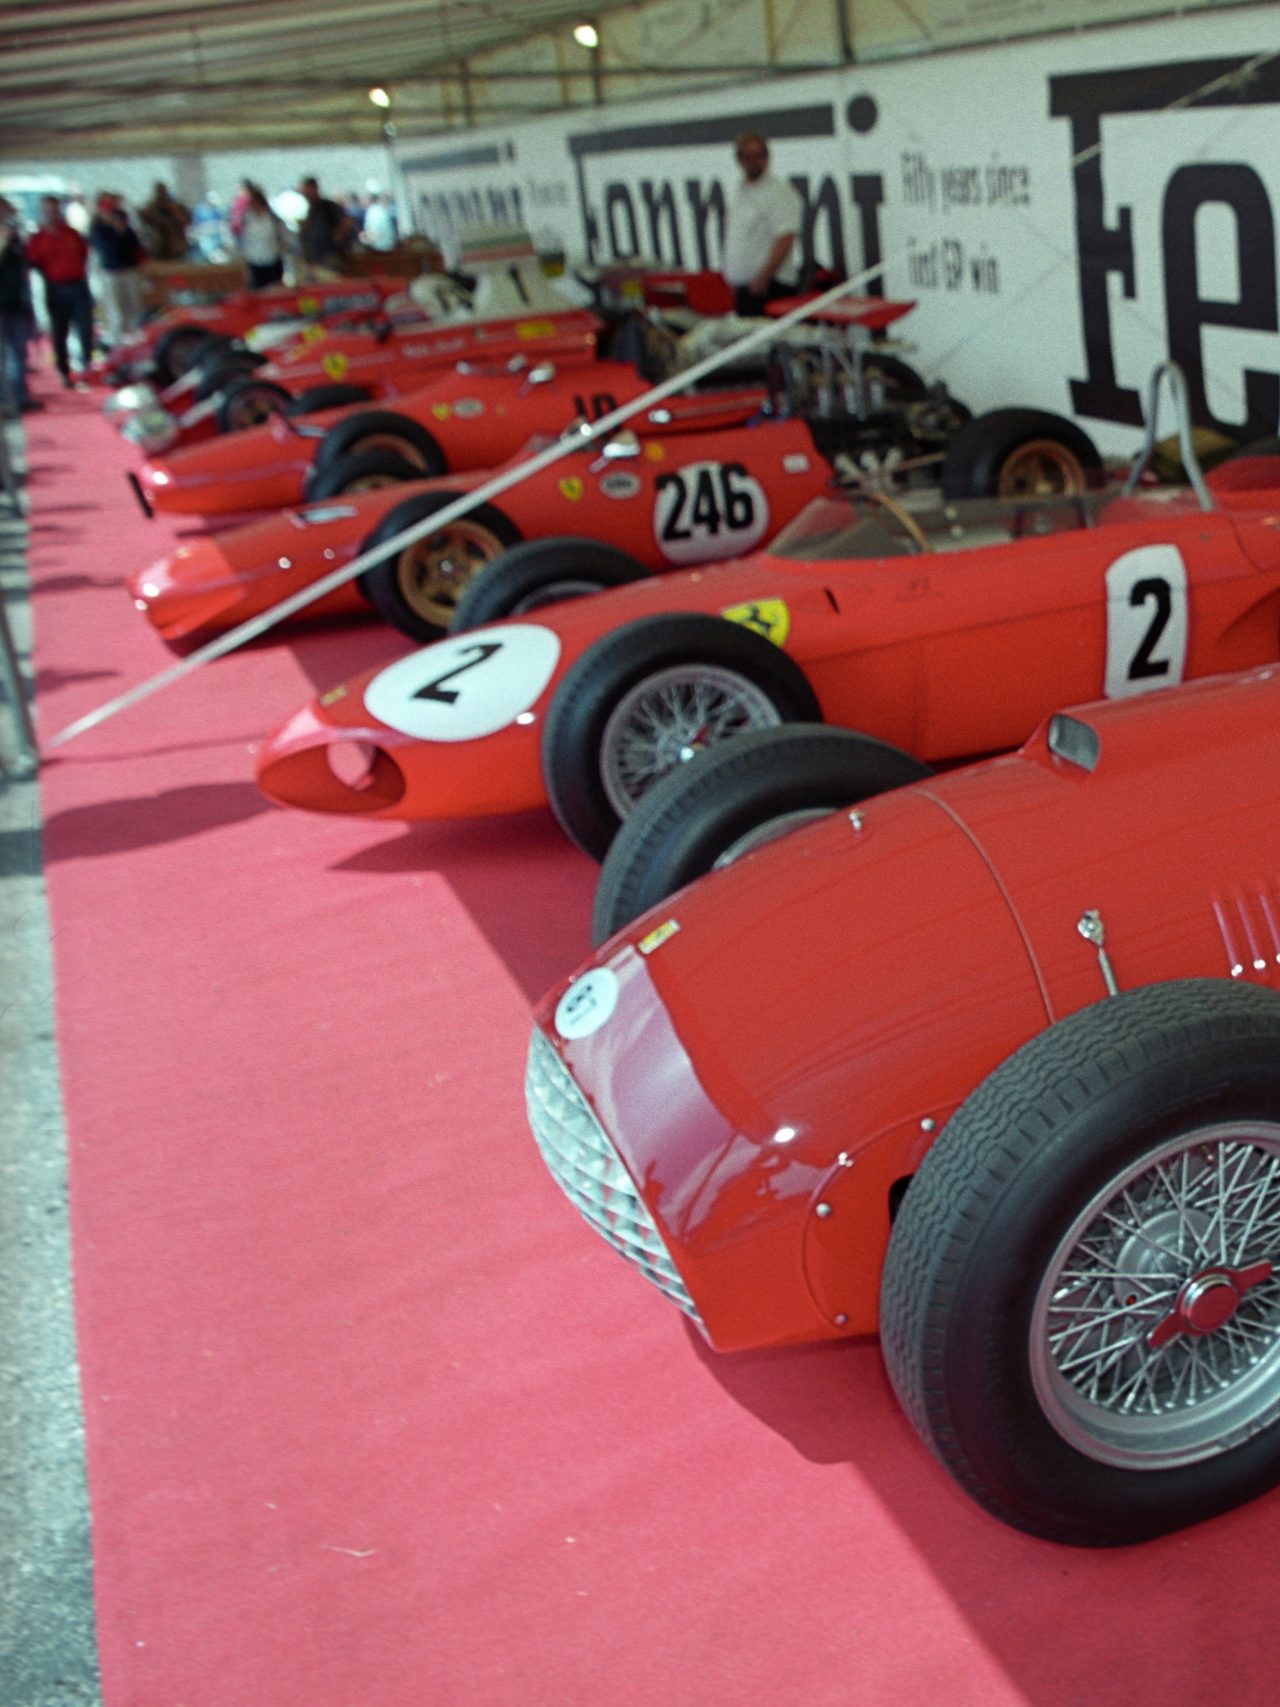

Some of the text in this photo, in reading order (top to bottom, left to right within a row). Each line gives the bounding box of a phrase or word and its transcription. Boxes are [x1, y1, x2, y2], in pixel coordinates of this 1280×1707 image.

[568, 94, 888, 342] Ferrri
[656, 462, 756, 541] 246
[411, 642, 505, 705] 2
[1126, 577, 1172, 681] 2
